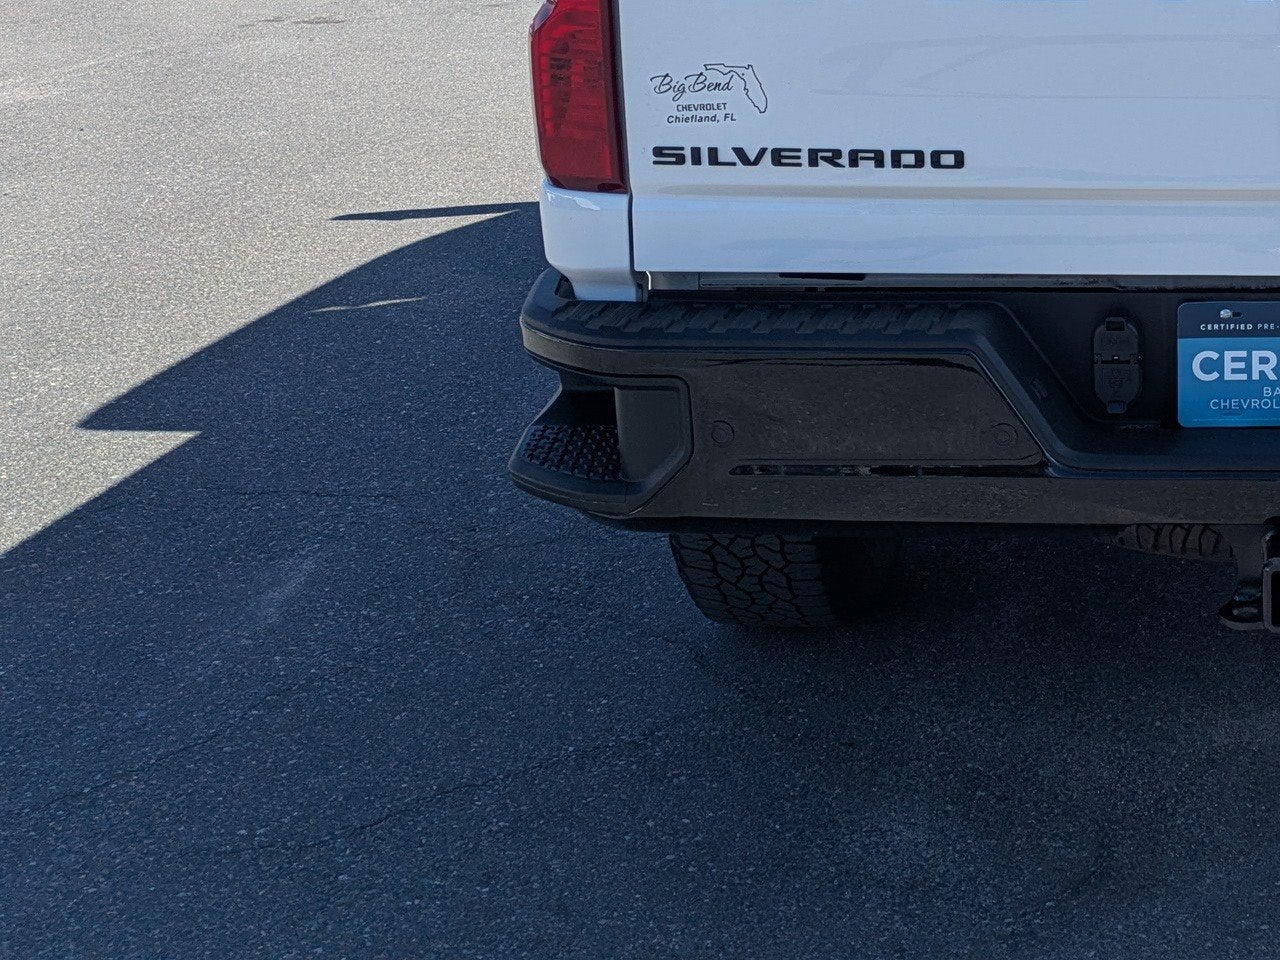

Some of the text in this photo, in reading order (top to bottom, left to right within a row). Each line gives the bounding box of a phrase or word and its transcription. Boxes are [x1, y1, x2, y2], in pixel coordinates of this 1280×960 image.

[650, 72, 734, 102] Big Bend
[676, 102, 727, 112] CHEVROLET
[667, 113, 737, 124] Chiefland, FL
[652, 146, 965, 169] SILVERADO
[1200, 323, 1253, 331] CERTIFIED
